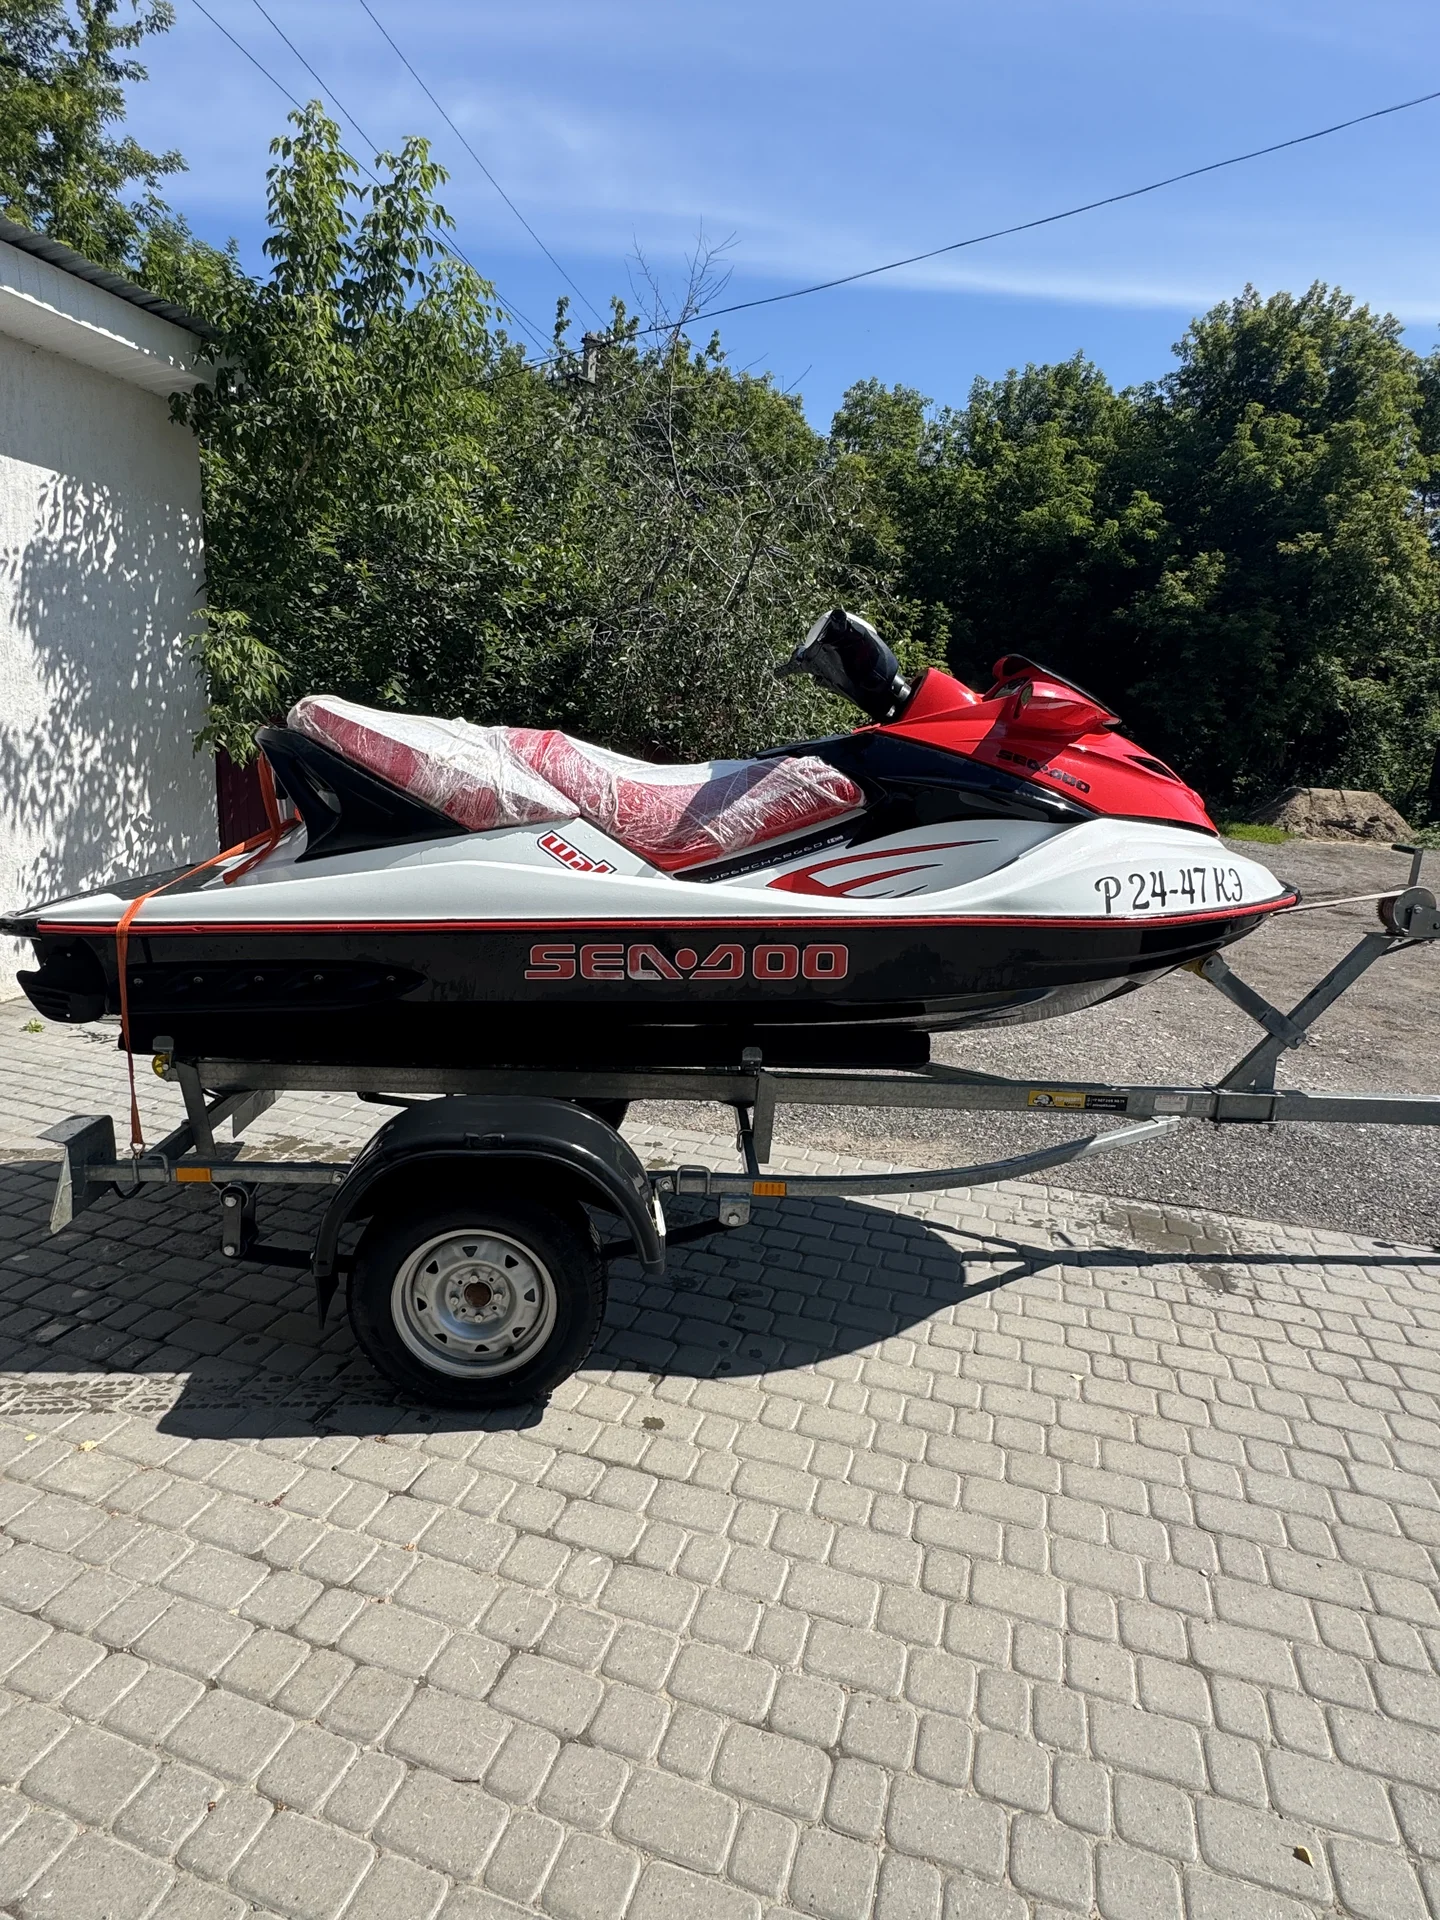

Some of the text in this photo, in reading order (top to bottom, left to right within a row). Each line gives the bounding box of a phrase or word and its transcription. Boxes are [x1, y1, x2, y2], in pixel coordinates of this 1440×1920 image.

[699, 842, 823, 883] SUPERCHARGED
[1128, 867, 1206, 910] 24-47
[1212, 867, 1243, 905] КЭ
